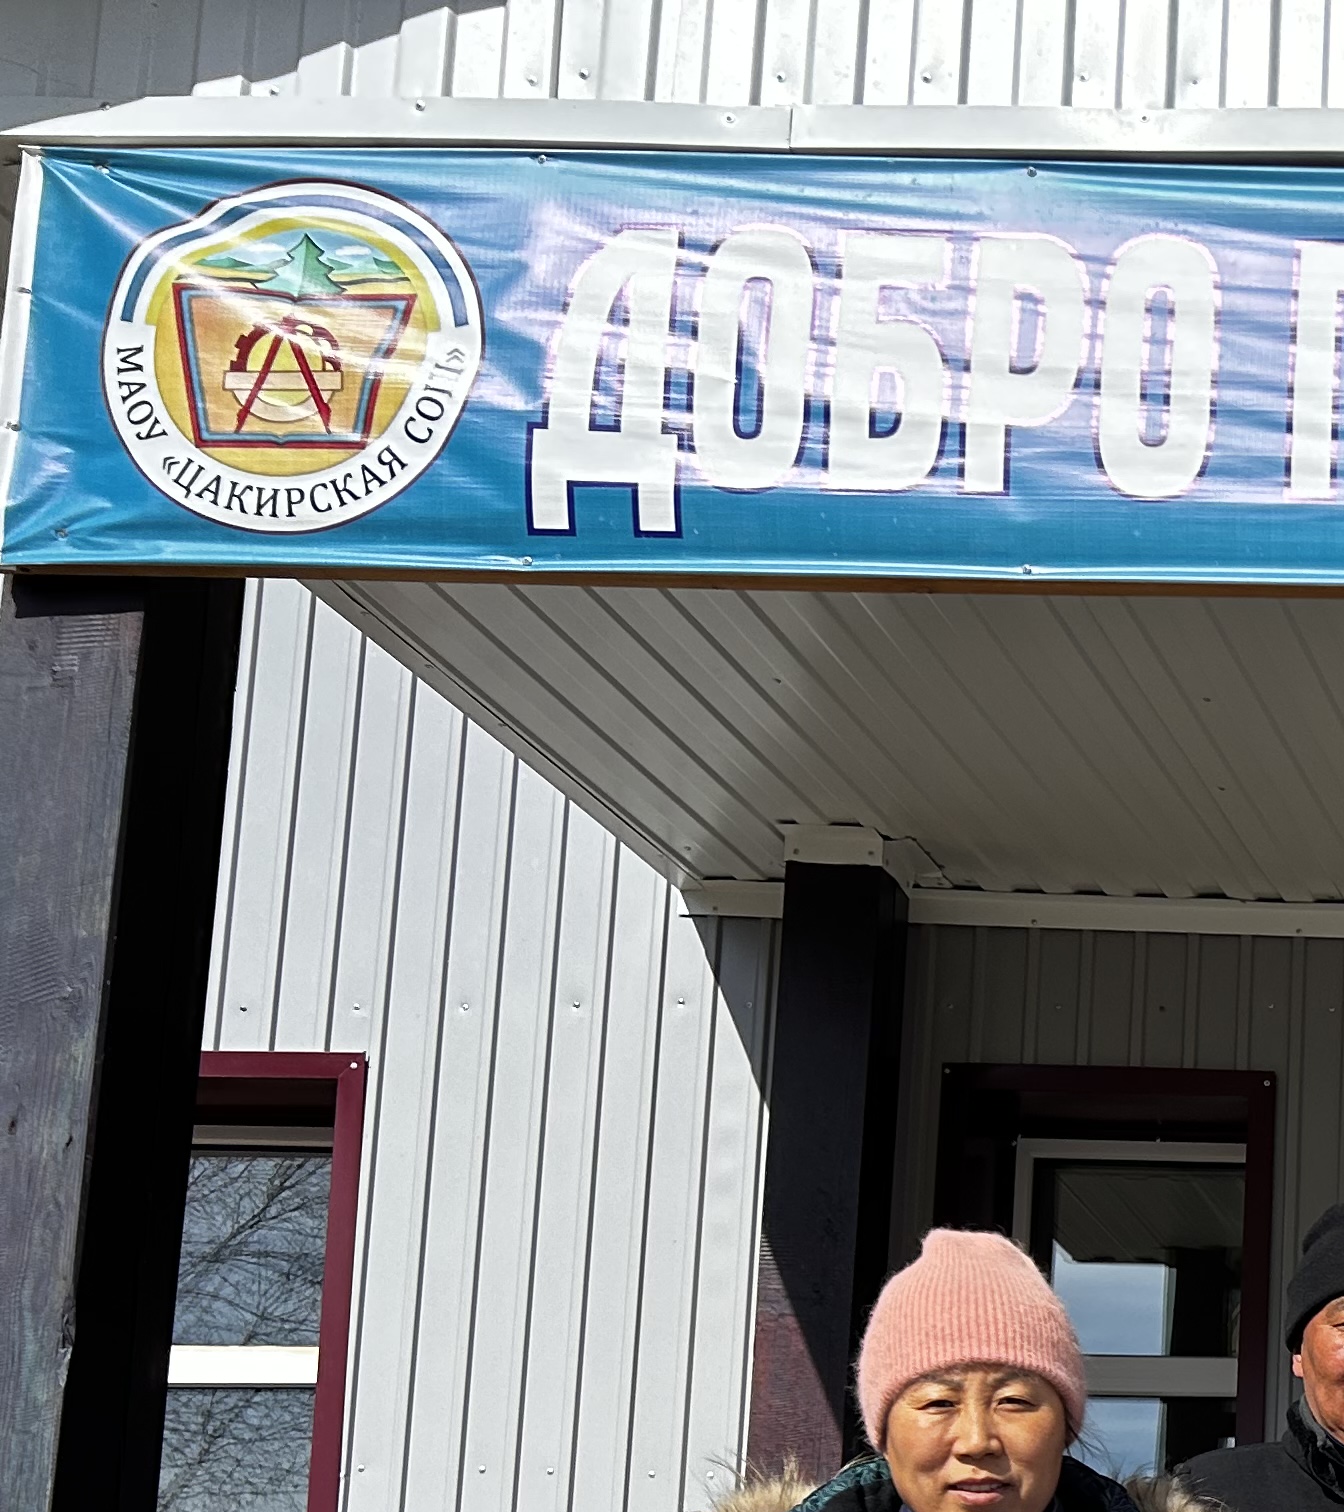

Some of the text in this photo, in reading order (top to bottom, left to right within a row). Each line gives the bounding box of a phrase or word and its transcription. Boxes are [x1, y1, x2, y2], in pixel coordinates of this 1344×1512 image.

[116, 344, 168, 443] МАОУ
[162, 446, 408, 519] «ЦАКИРСКАЯ
[525, 222, 1219, 538] ДОБРО
